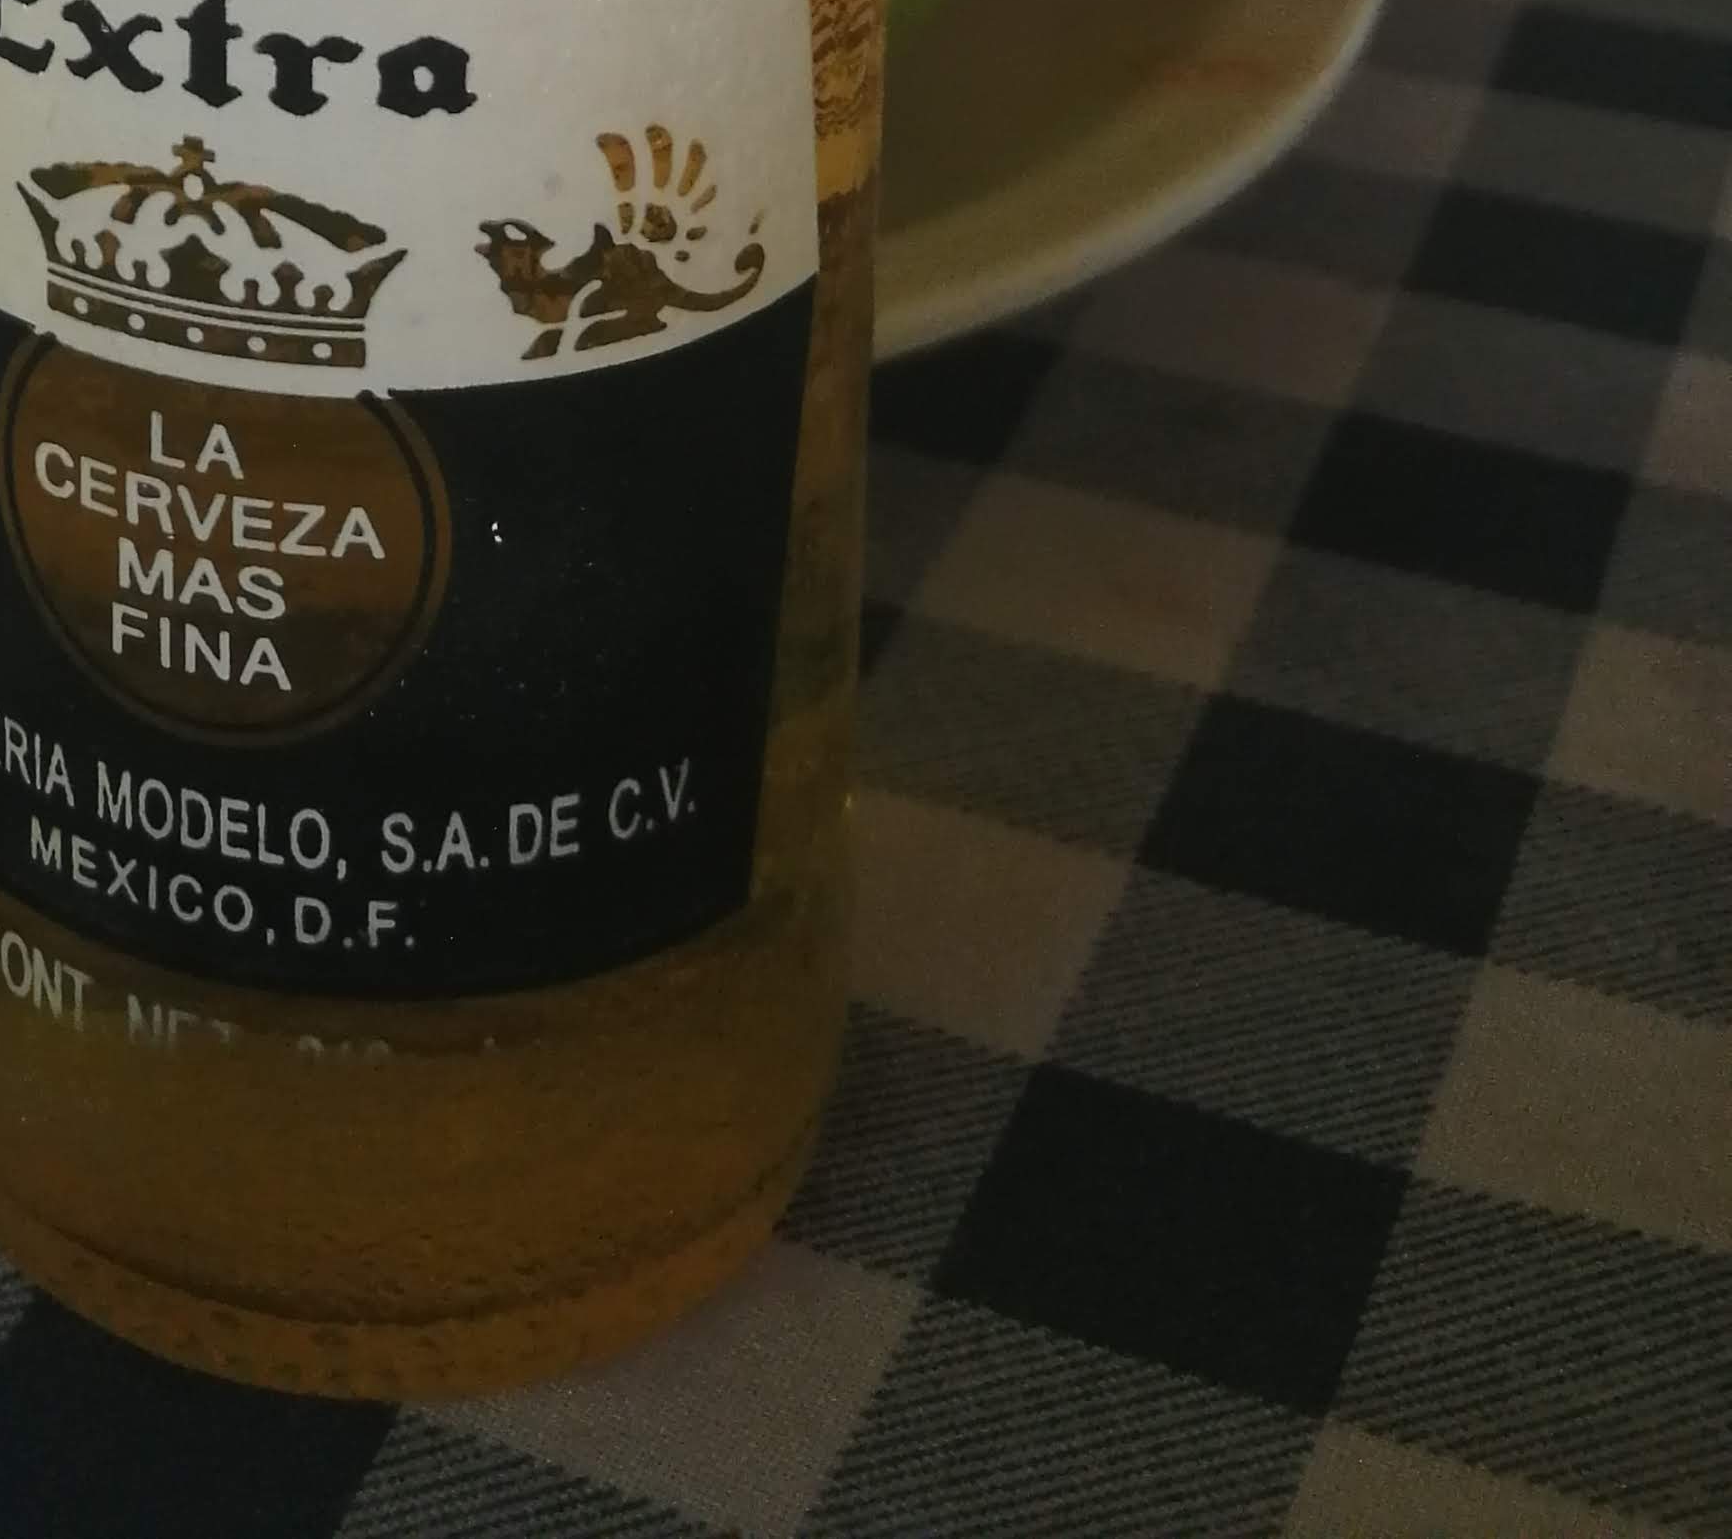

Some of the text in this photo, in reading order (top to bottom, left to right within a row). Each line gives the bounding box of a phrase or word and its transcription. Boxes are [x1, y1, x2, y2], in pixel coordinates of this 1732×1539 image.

[150, 410, 244, 479] LA
[33, 441, 385, 559] CERVEZA
[118, 536, 287, 619] MAS
[111, 601, 292, 690] FINA
[97, 760, 348, 879] MODELO,
[509, 793, 580, 865] DE
